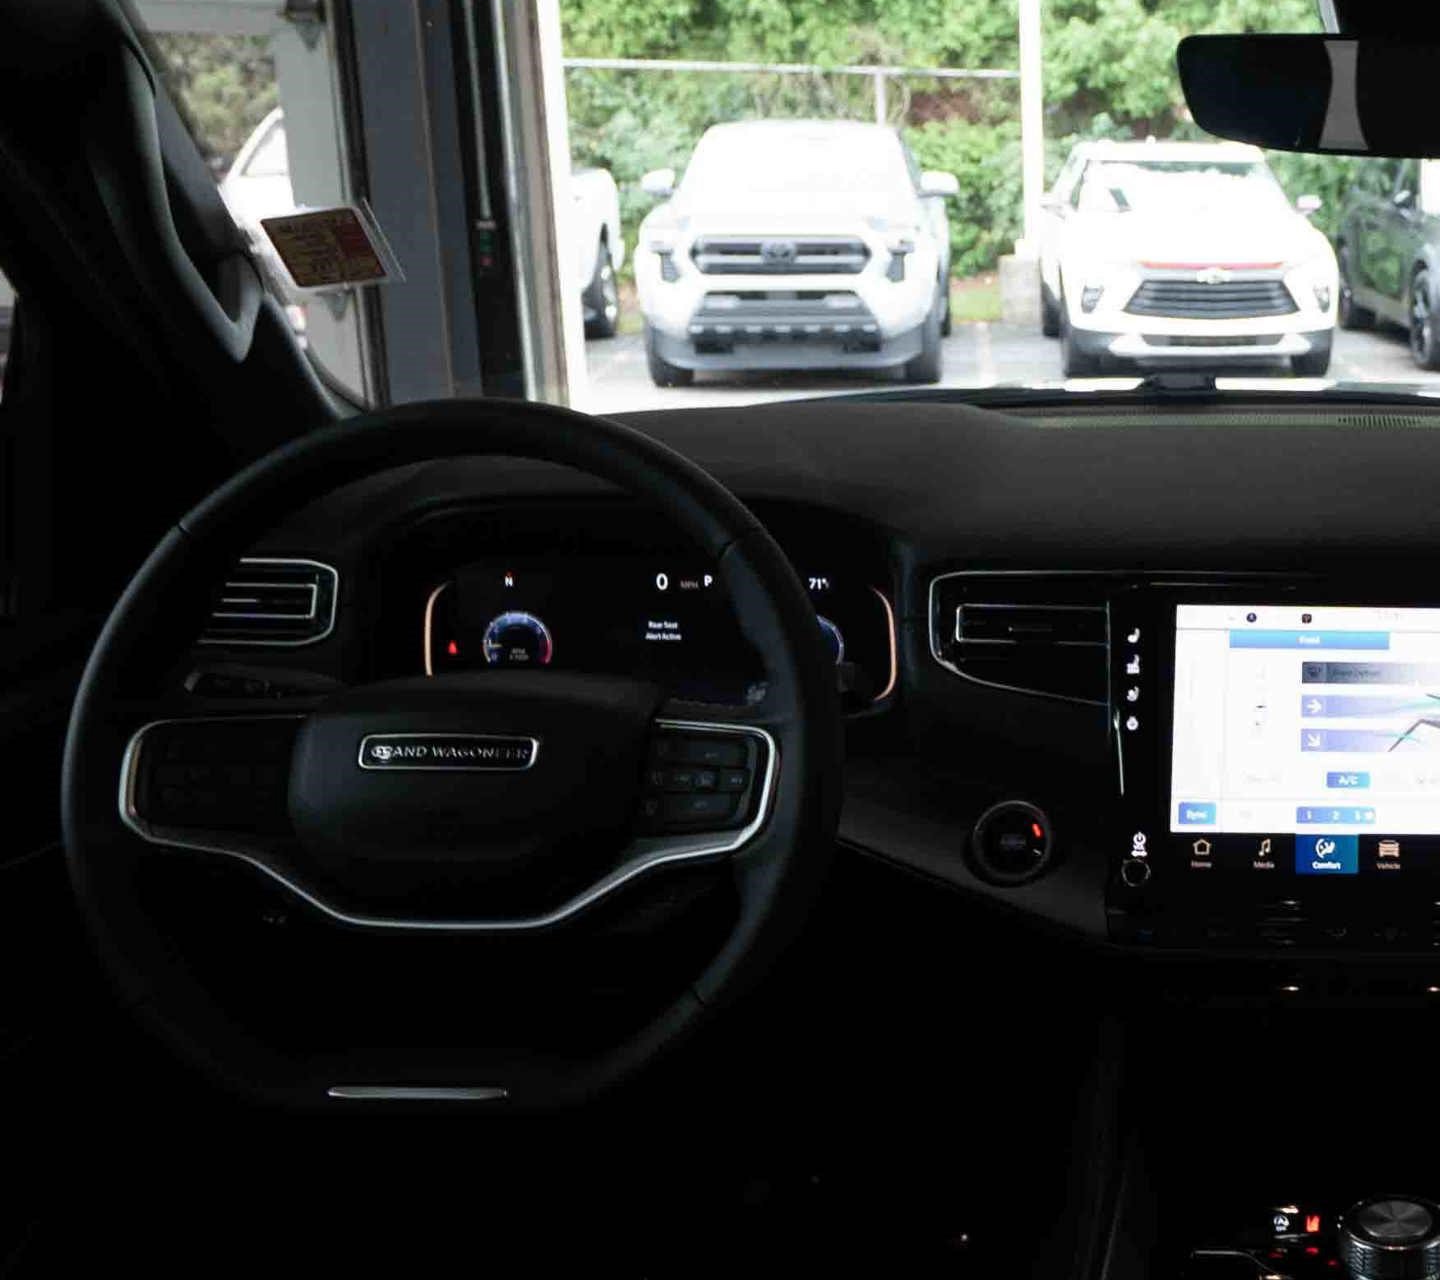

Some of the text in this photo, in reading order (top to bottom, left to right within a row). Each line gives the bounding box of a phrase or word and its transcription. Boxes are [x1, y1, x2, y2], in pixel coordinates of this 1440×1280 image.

[655, 572, 669, 591] 0
[703, 574, 714, 588] P
[1337, 773, 1359, 786] A/C
[1311, 860, 1342, 871] Comfort
